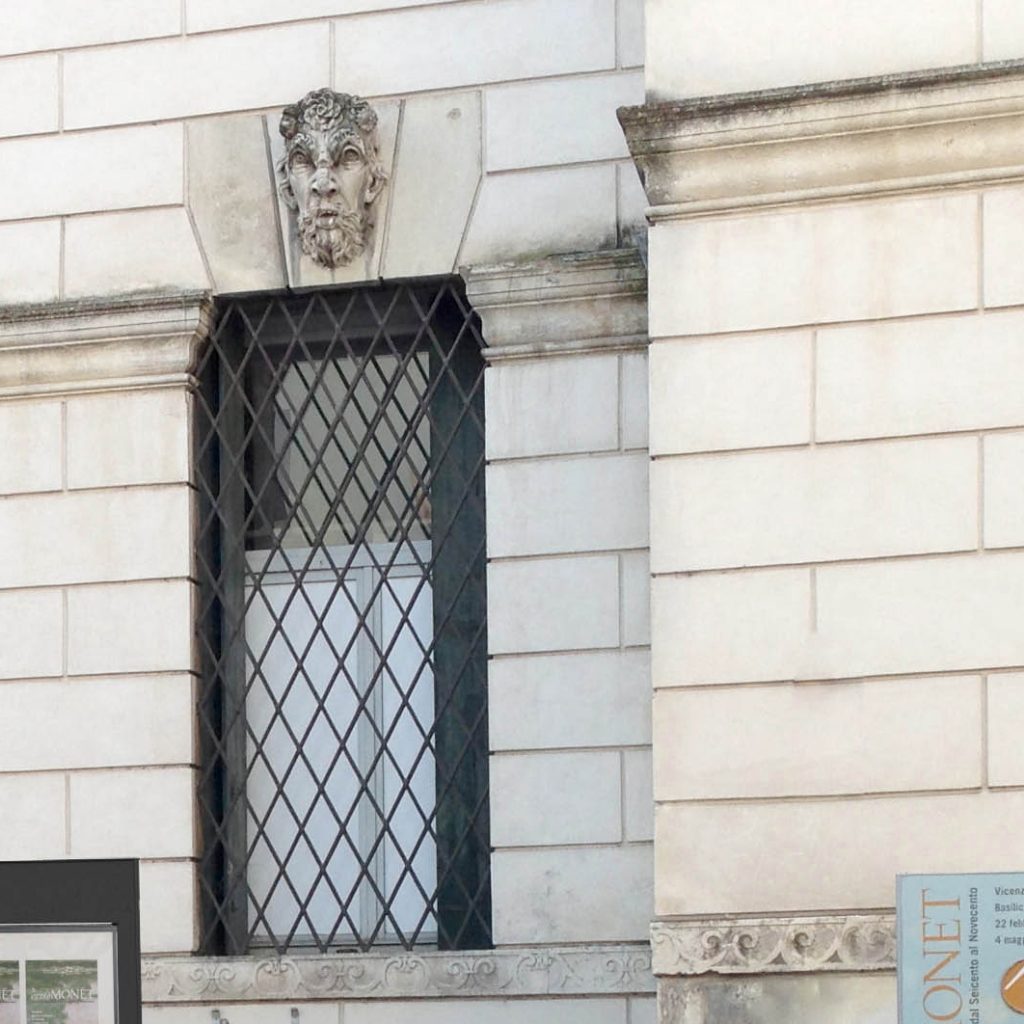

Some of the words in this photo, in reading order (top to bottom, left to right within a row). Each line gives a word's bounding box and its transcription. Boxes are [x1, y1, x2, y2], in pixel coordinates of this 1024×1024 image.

[968, 887, 979, 942] Novecento
[995, 919, 1007, 929] 22
[994, 936, 1001, 945] 4
[968, 946, 979, 956] al
[969, 959, 980, 1005] Seicento
[970, 1008, 980, 1024] dal
